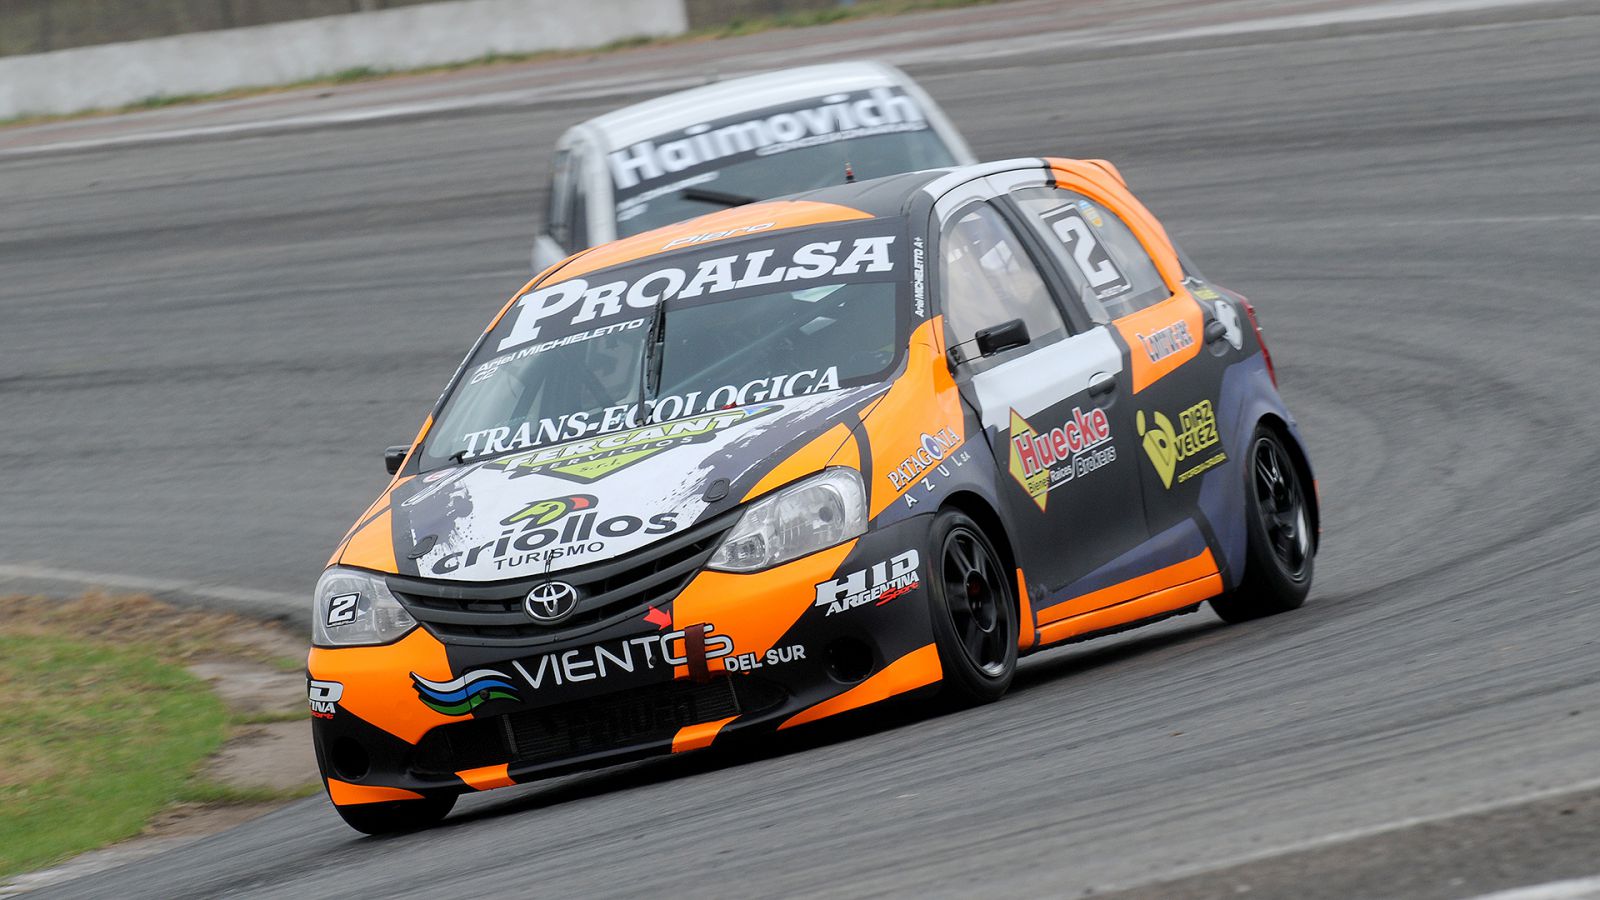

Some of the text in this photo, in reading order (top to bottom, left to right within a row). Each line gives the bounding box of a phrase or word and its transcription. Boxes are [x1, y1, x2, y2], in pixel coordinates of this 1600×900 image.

[608, 86, 923, 190] Haimovich
[1052, 216, 1120, 288] 2
[497, 236, 896, 352] PROALSA
[473, 353, 518, 376] Ariel
[517, 318, 645, 359] MICHIELETTO
[463, 366, 841, 458] TRANS-ECOLOGICA
[502, 412, 746, 473] FERCANT
[532, 436, 694, 473] SERVICIOS
[887, 425, 961, 492] PATAGONIA
[1012, 406, 1110, 480] Huecke
[432, 507, 679, 574] criollos
[493, 541, 605, 570] TURISMO
[815, 549, 919, 607] HID
[825, 571, 920, 616] ARGENTINA
[875, 582, 919, 607] Sport
[328, 595, 357, 624] 2
[725, 652, 762, 673] DEL
[766, 644, 806, 666] SUR
